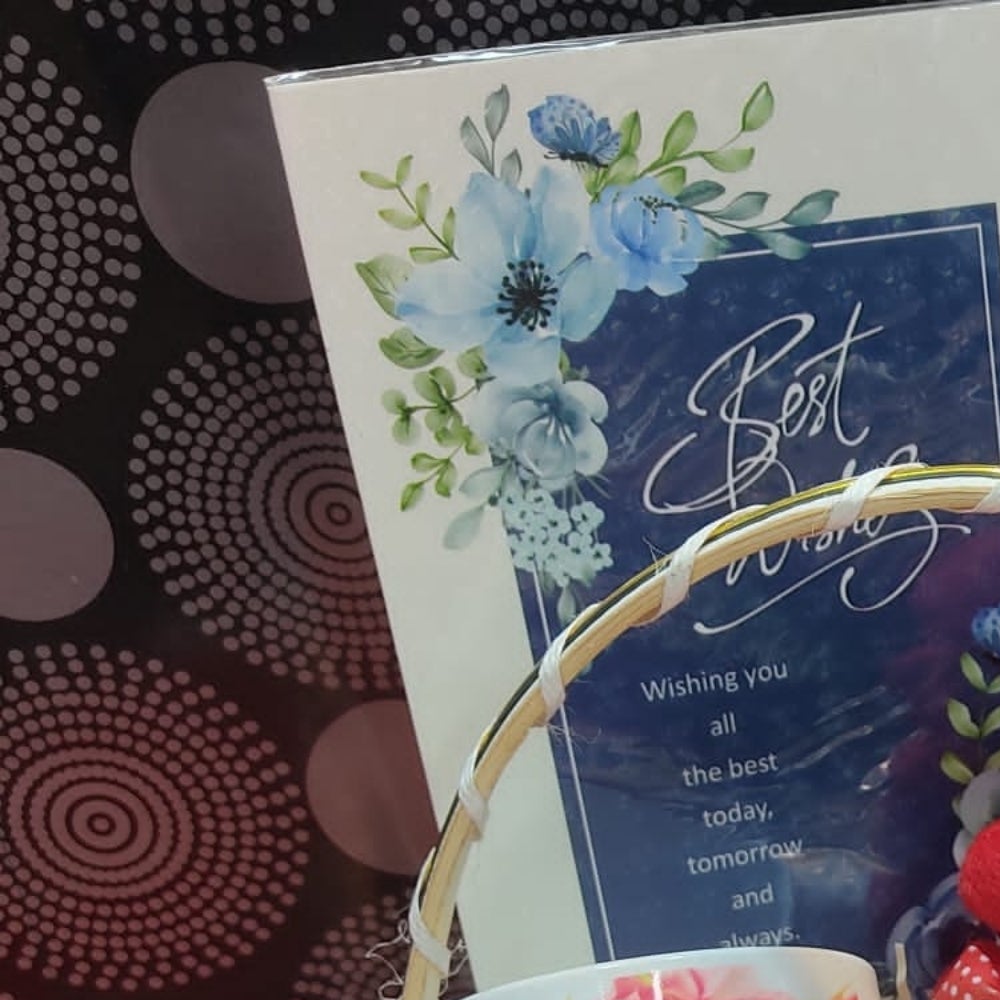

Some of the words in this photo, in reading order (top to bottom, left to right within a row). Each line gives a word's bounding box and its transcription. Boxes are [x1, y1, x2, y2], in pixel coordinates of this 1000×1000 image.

[643, 302, 884, 512] Best
[641, 669, 739, 702] Wishing
[745, 660, 789, 692] you
[710, 711, 737, 737] all
[682, 762, 724, 787] the
[729, 752, 779, 781] best
[703, 800, 774, 828] today,
[687, 836, 803, 876] tomorrow
[731, 882, 774, 911] and
[720, 926, 801, 947] always.
